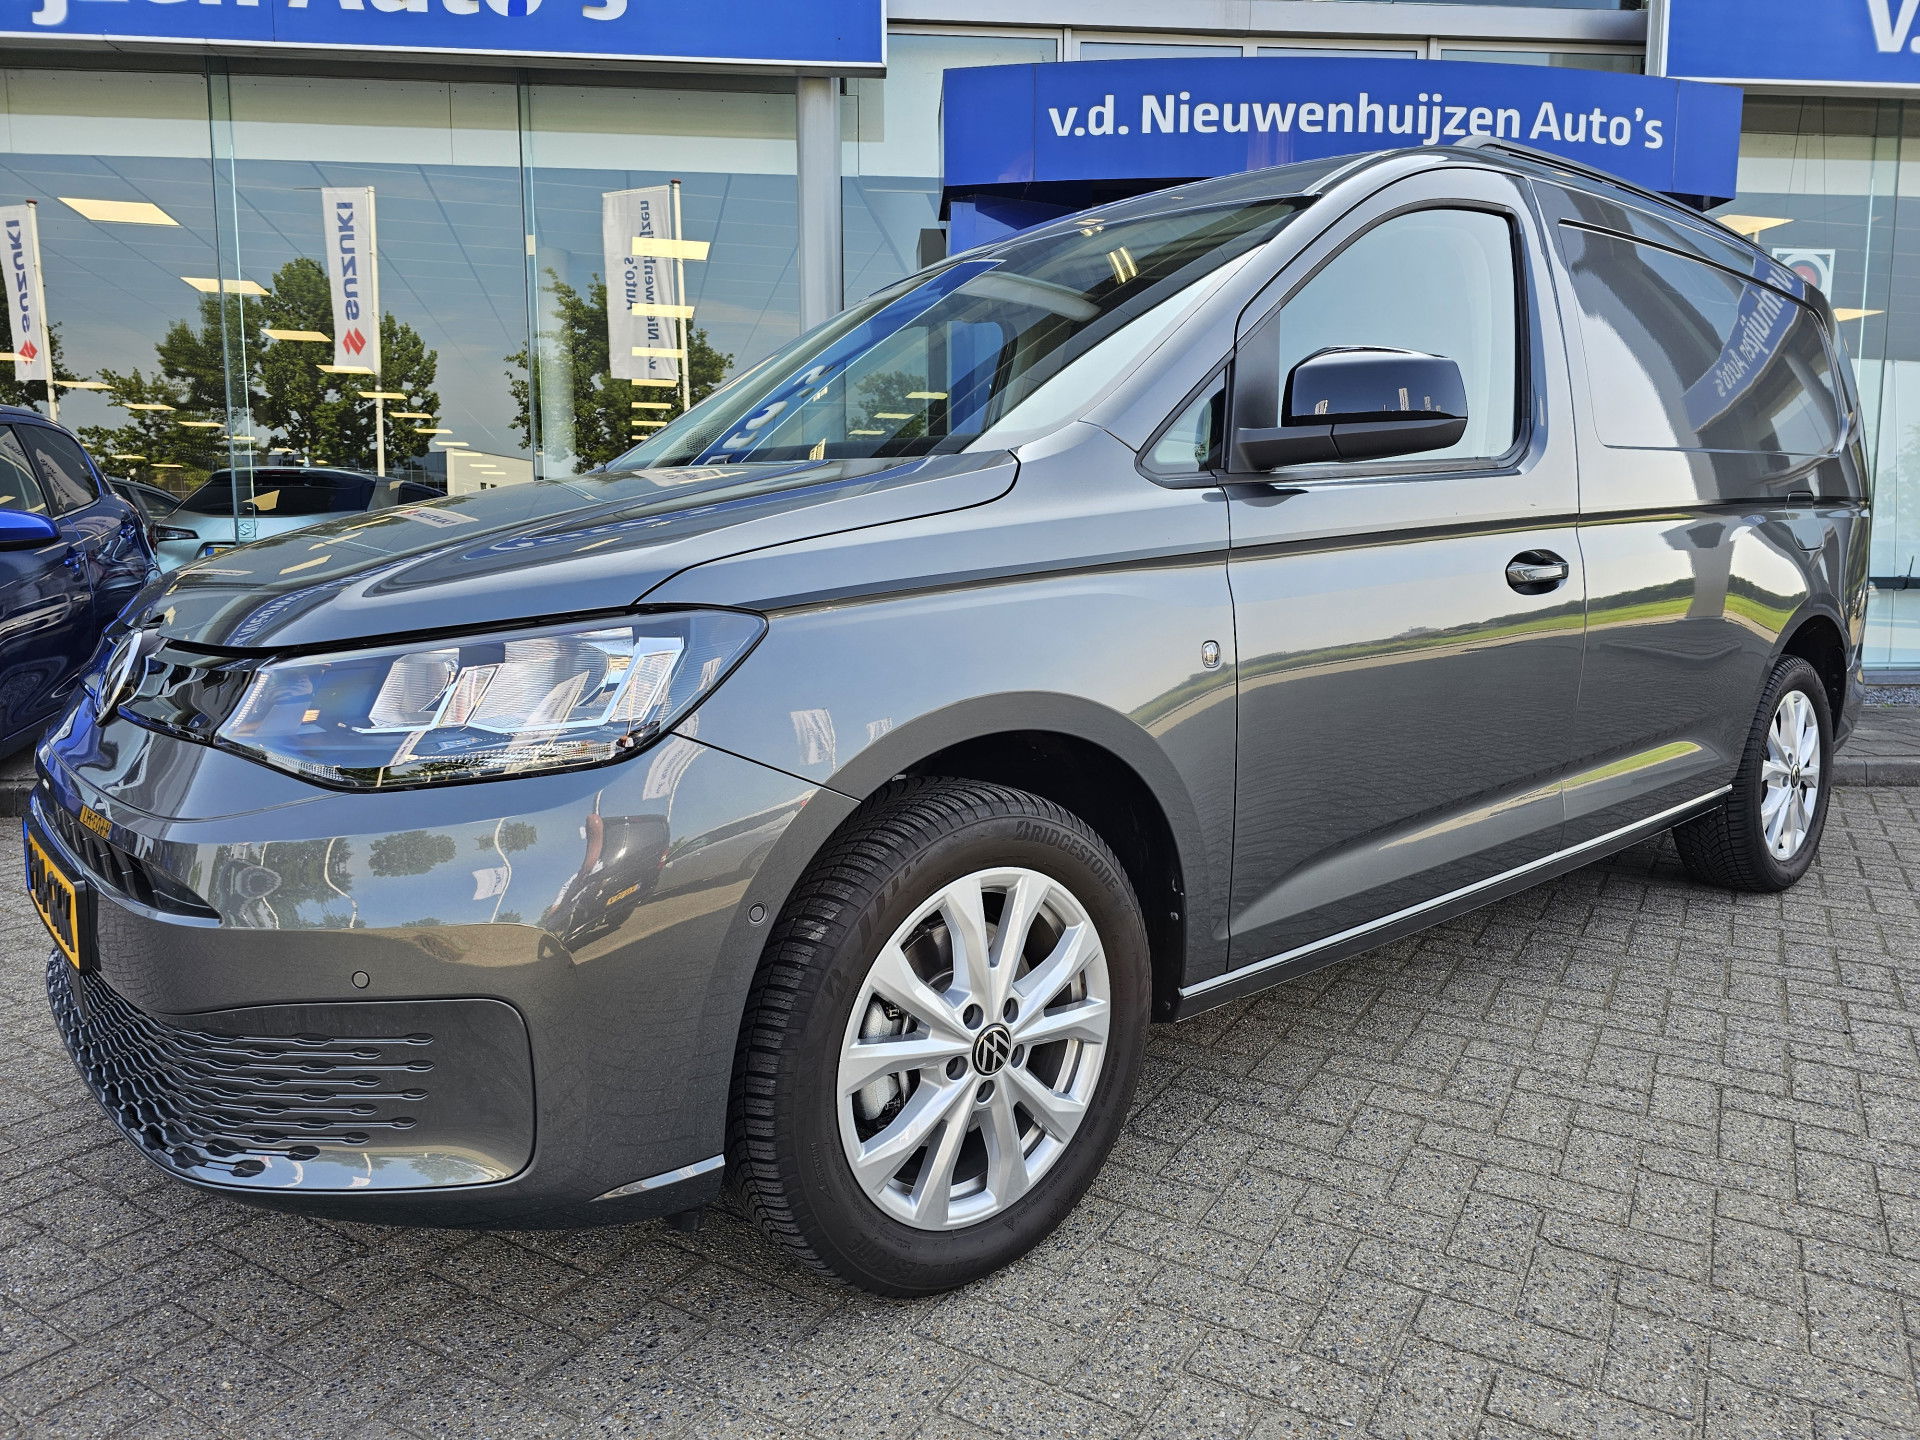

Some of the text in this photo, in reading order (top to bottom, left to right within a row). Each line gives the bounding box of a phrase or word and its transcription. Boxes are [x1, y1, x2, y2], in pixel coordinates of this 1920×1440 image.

[1048, 91, 1664, 150] v.d. Nieuwenhuijzen Auto's
[1015, 820, 1119, 893] BRIDGESTONE
